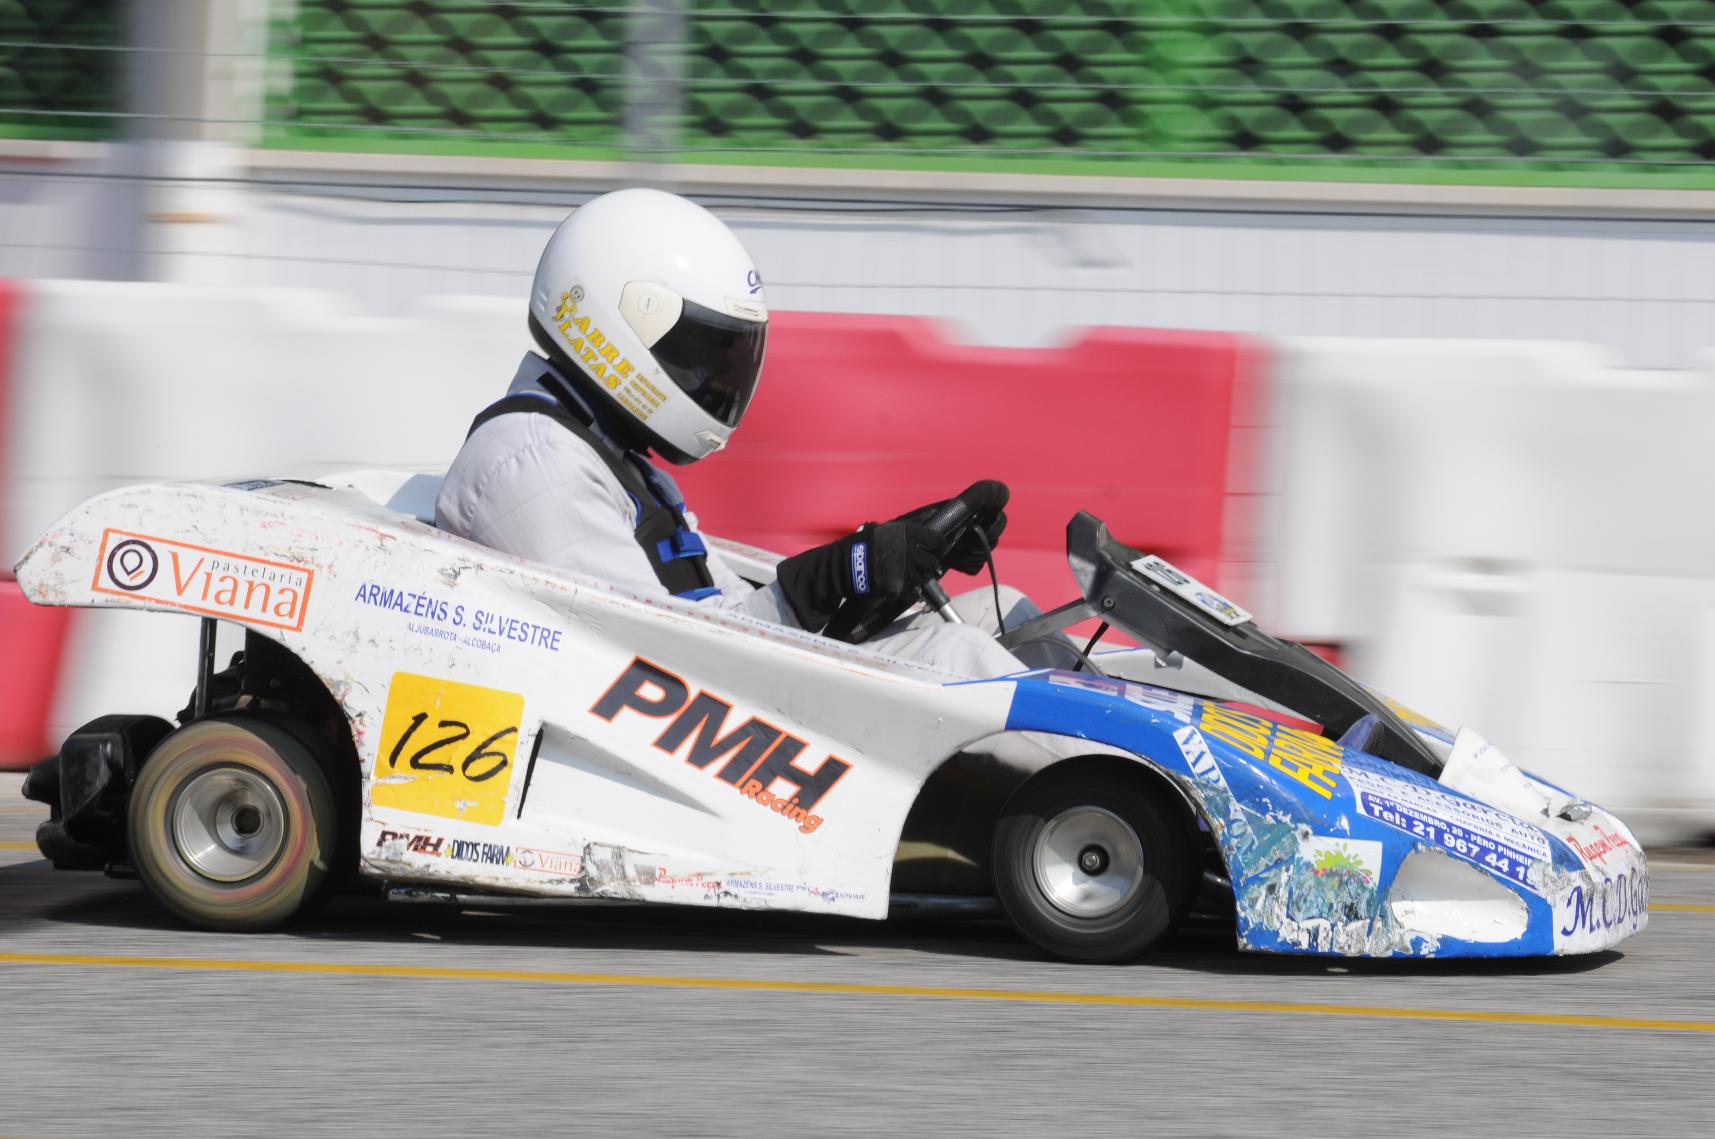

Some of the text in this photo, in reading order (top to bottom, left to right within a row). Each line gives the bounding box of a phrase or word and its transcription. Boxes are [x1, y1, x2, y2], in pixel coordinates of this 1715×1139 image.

[558, 321, 622, 390] LATAS
[572, 316, 635, 379] ABRE
[168, 551, 299, 619] Viana
[211, 559, 302, 587] pastelaria
[853, 544, 867, 591] sparco
[354, 583, 449, 622] ARMAZÉNS
[452, 605, 466, 628] S.
[472, 610, 563, 651] SILVESTRE
[407, 622, 457, 642] ALJUBARROTA
[462, 637, 501, 653] ALCOBAÇA
[389, 712, 518, 782] 126
[587, 655, 853, 812] PMH
[740, 778, 824, 833] Racing
[1452, 826, 1464, 837] 20
[481, 843, 510, 865] FARM
[1369, 803, 1406, 828] Tel:
[1412, 820, 1435, 841] 21
[1443, 833, 1480, 858] 967
[1484, 852, 1510, 873] 44
